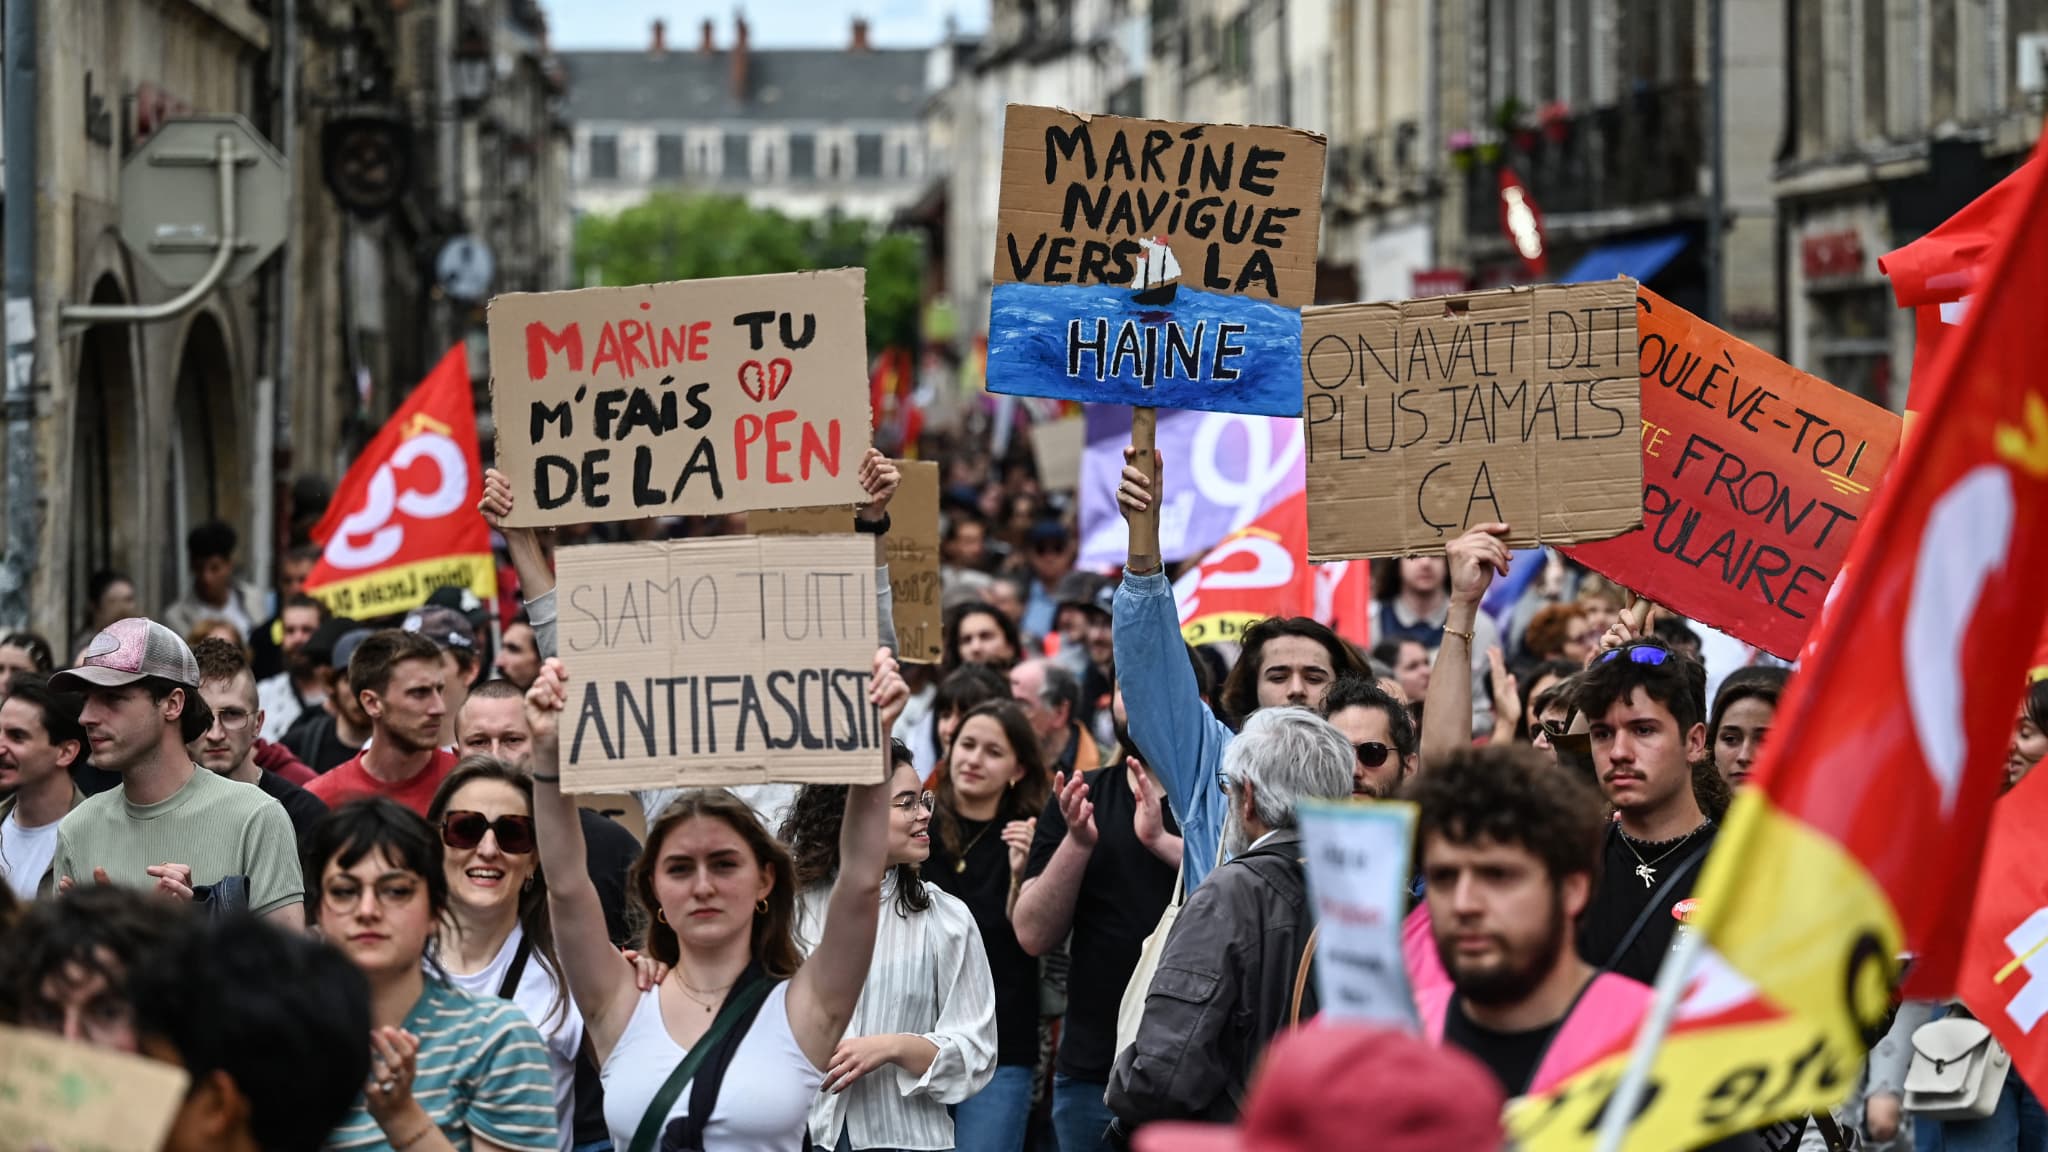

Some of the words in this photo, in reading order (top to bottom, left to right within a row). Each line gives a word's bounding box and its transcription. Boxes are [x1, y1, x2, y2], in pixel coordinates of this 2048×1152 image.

[1045, 124, 1285, 196] MARINE
[1061, 182, 1300, 249] NAVIGUE
[1007, 232, 1142, 284] VERS
[1204, 242, 1278, 298] LA
[525, 302, 712, 381] MARINE
[733, 310, 816, 351] TU
[1067, 317, 1247, 388] HAINE
[1547, 306, 1637, 370] DIT
[530, 375, 712, 444] M'FAIS
[533, 448, 610, 510] DE
[633, 435, 724, 508] LA
[733, 410, 841, 484] PEN
[1672, 434, 1857, 549] FRONT
[1418, 461, 1504, 537] ÇA
[569, 575, 718, 652] SIAMO
[736, 570, 867, 641] TUTTI
